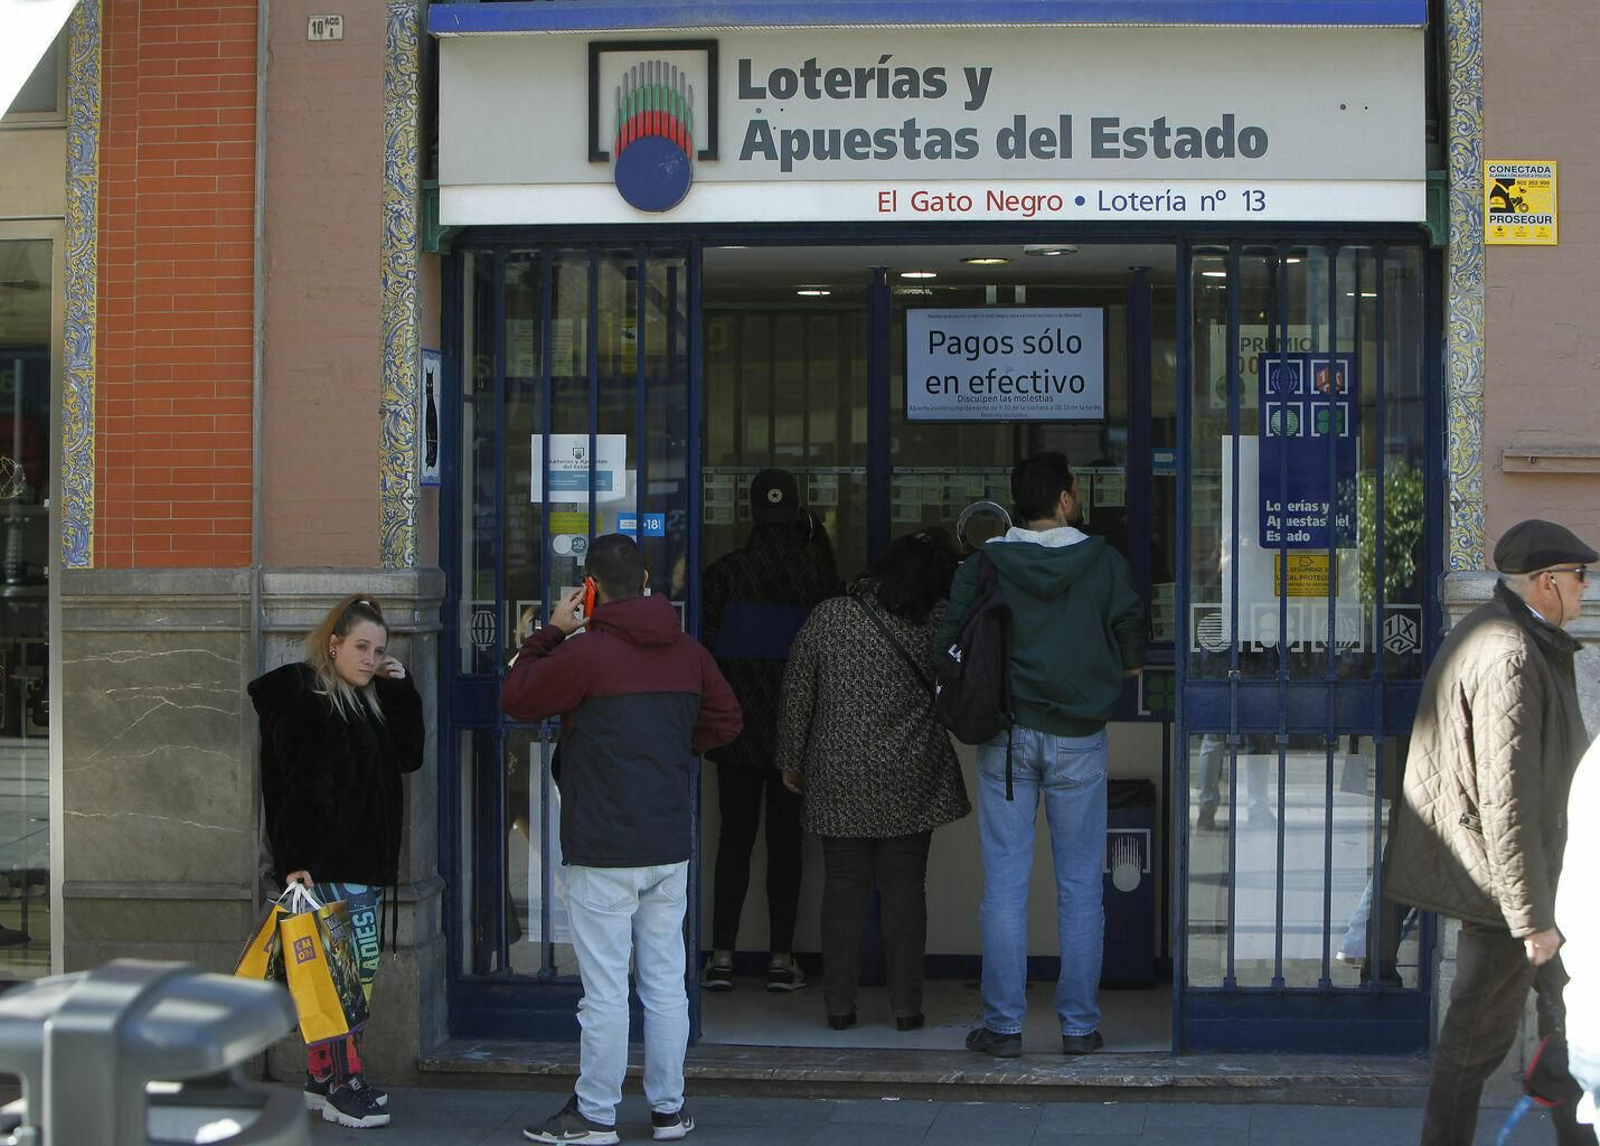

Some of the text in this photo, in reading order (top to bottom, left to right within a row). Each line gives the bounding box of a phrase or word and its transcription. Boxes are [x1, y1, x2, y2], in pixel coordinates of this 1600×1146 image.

[312, 20, 323, 35] 10
[737, 54, 993, 111] Loterías y
[738, 114, 1269, 172] Apuestas del Estado
[1489, 165, 1551, 173] CONECTADA
[877, 188, 1267, 218] El Gato Negro Lotería nº 13
[1489, 215, 1552, 224] PROSEGUR
[929, 328, 1083, 361] Pagos sólo
[926, 368, 1085, 394] en efectivo
[958, 395, 998, 404] Disculpen
[1013, 394, 1054, 402] molestias
[1266, 500, 1329, 514] Loerías y
[1266, 530, 1311, 541] Esado
